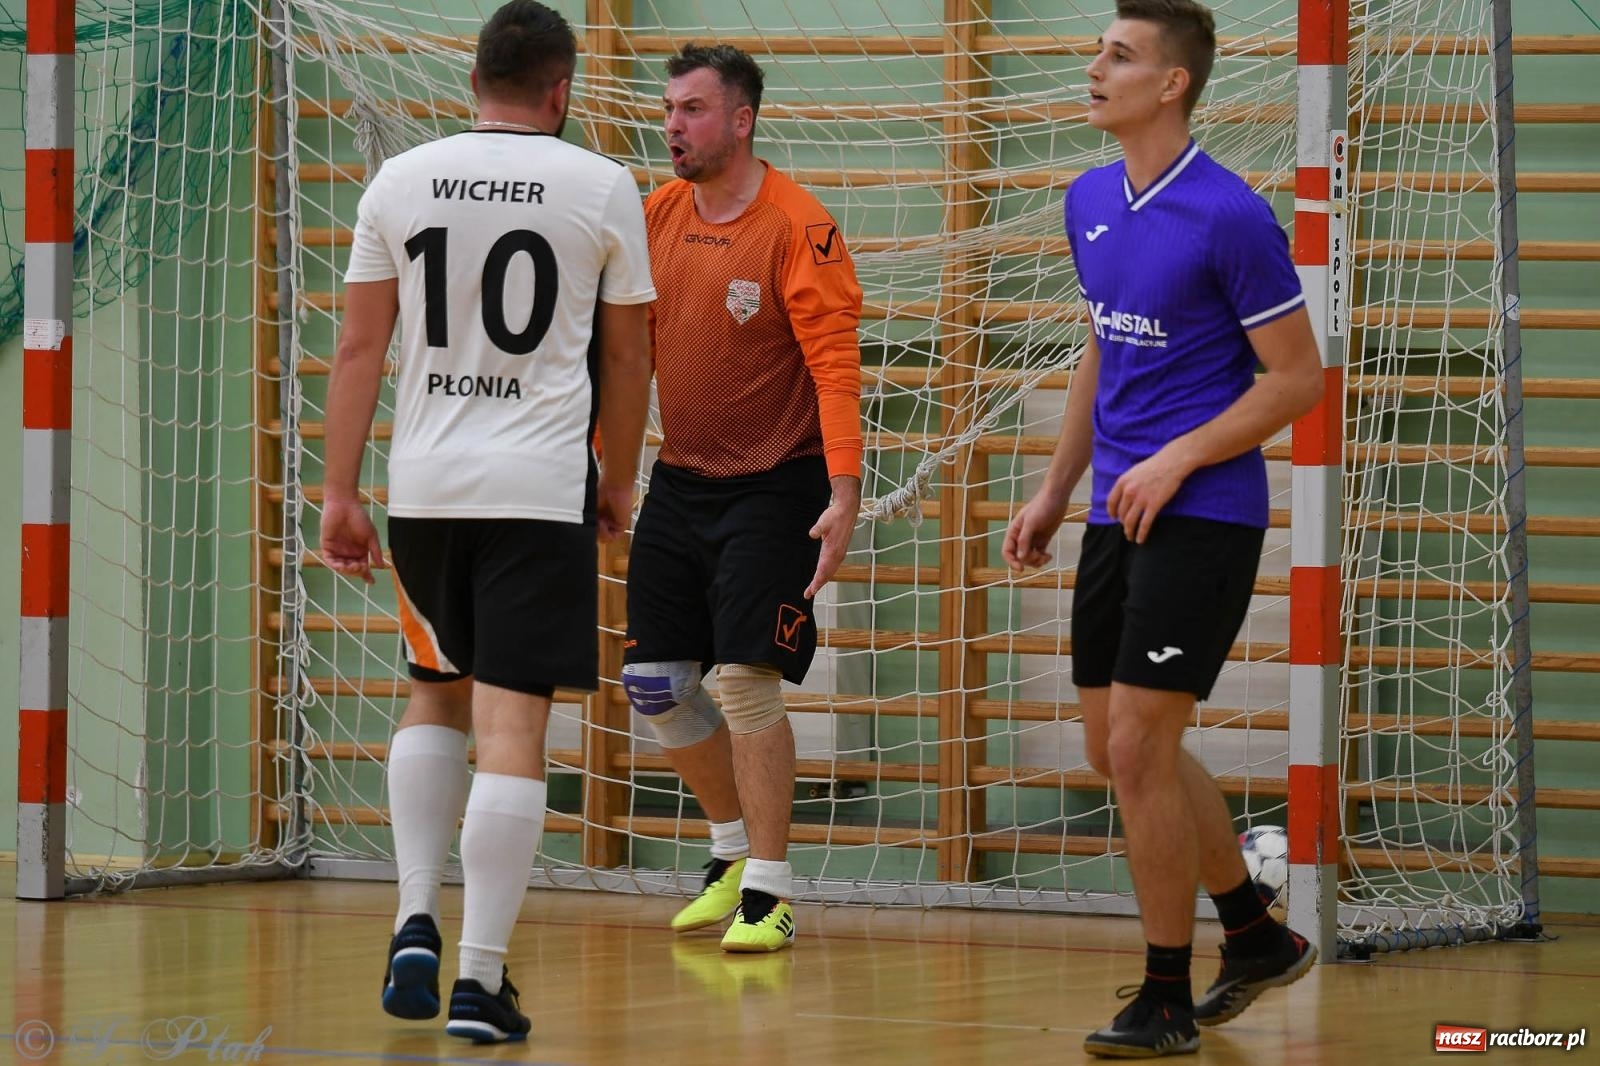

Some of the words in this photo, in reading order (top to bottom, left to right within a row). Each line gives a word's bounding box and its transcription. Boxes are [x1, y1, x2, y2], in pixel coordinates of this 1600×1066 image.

[432, 178, 545, 204] WICHER
[404, 226, 559, 355] 10
[1333, 238, 1341, 332] sport
[428, 373, 521, 399] PŁONIA
